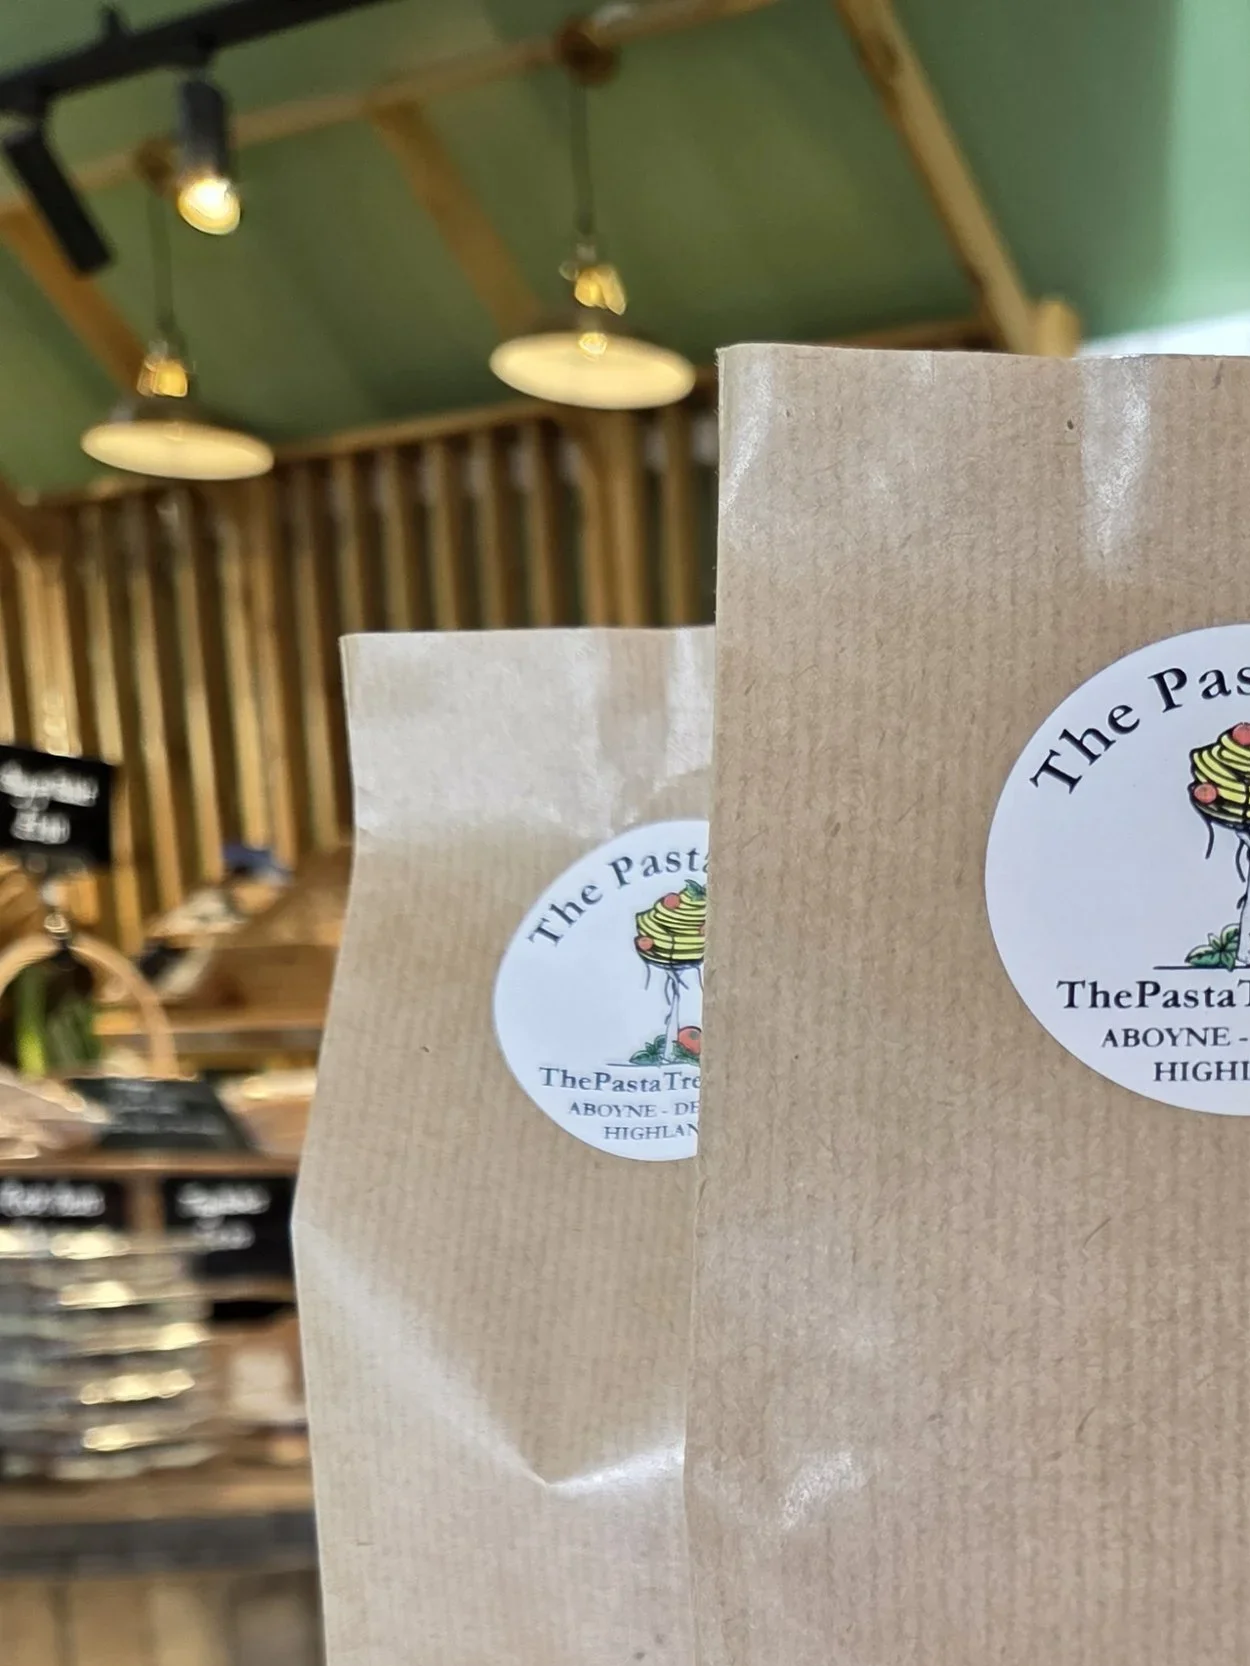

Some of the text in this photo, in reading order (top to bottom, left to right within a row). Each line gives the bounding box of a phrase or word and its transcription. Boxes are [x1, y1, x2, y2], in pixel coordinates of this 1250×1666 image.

[1030, 703, 1140, 794] The
[528, 882, 603, 948] The
[1101, 1027, 1231, 1048] ABOYNE
[539, 1067, 701, 1092] ThePastaTre
[567, 1101, 657, 1118] ABOYNE
[603, 1122, 699, 1140] HIGHLAN
